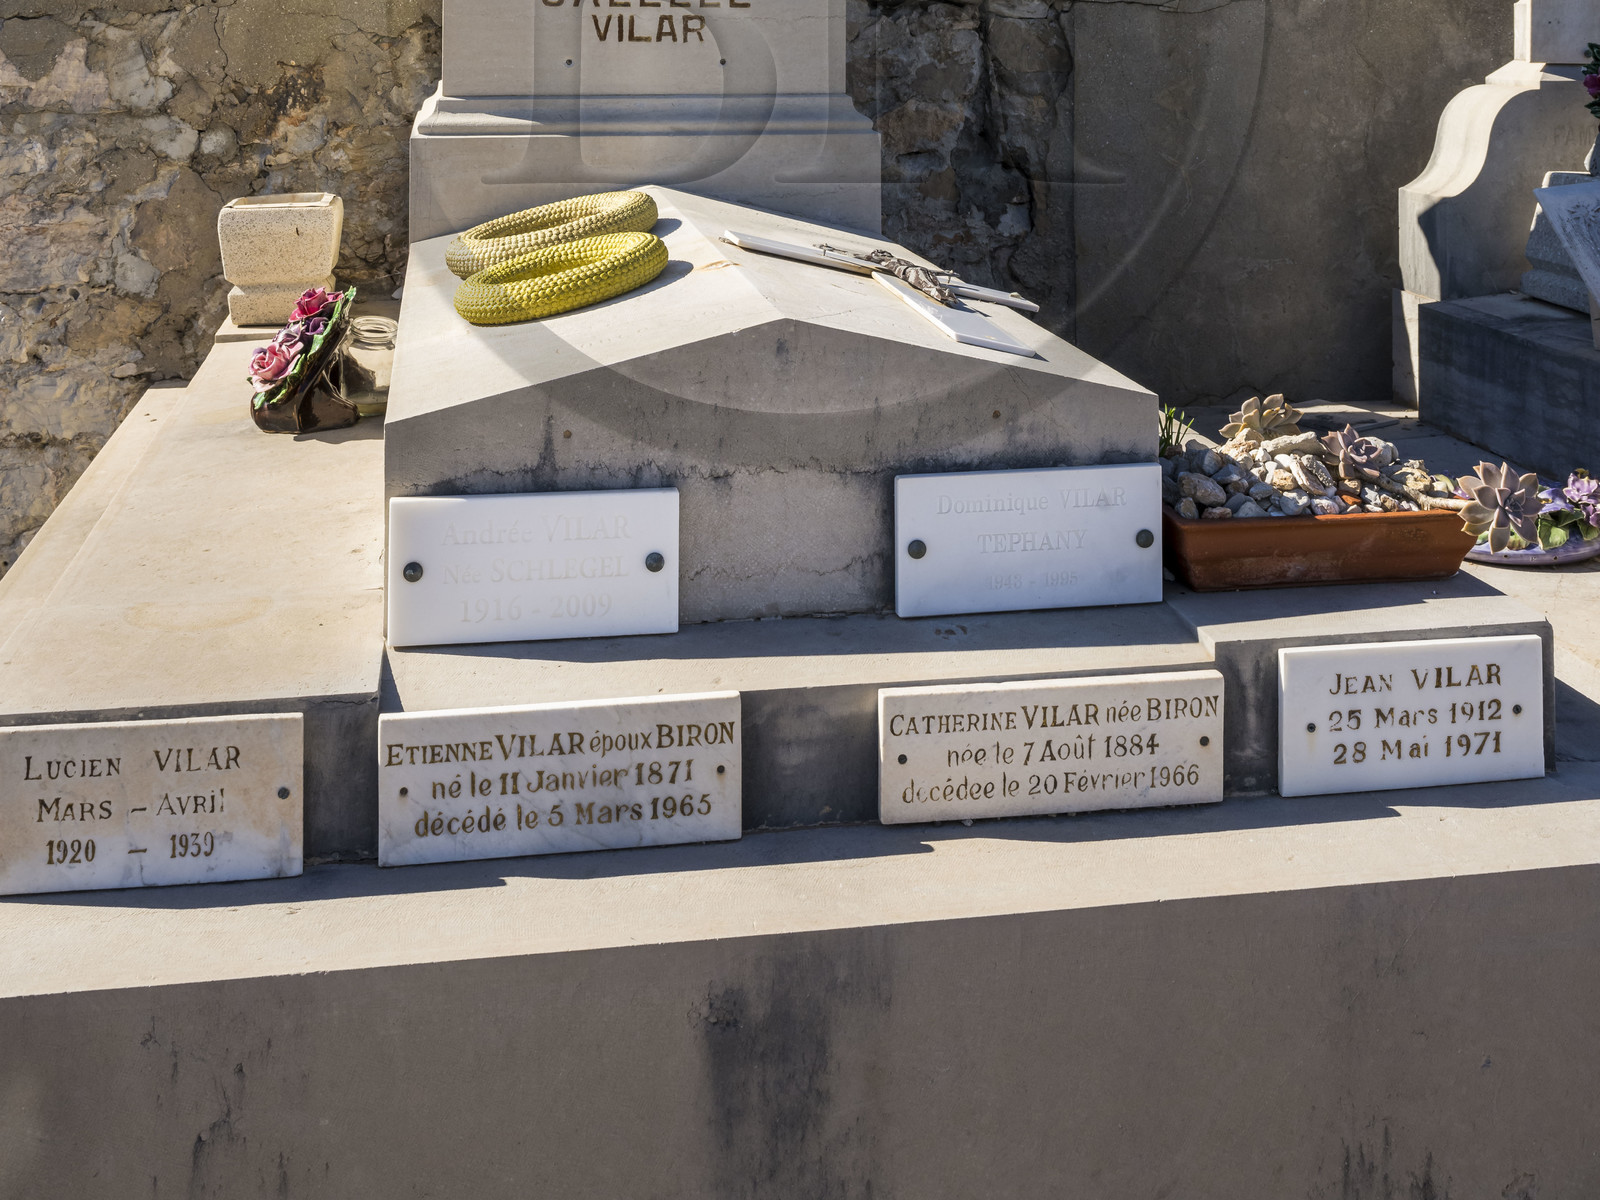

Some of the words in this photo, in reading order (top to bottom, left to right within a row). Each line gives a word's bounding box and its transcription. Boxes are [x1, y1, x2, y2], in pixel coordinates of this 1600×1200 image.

[591, 14, 706, 43] VILAR
[936, 492, 1049, 516] Dominique
[1058, 486, 1127, 509] VILAR
[440, 520, 533, 546] Andrée
[542, 514, 631, 542] VILAR
[976, 529, 1088, 554] TEPHANY
[442, 564, 481, 585] Née
[490, 555, 629, 583] SCHLEGEL
[460, 594, 522, 624] 1916
[549, 592, 613, 618] 2009
[1329, 673, 1393, 696] JEAN
[1410, 663, 1502, 690] VILAR
[889, 711, 1017, 737] CATHERINE
[1020, 703, 1100, 730] VILAR
[1106, 701, 1142, 724] née
[1146, 695, 1219, 721] BIRON
[1329, 709, 1362, 732] 25
[1374, 707, 1438, 729] Mars
[1450, 698, 1502, 724] 1912
[385, 740, 493, 768] ETIENNE
[494, 732, 586, 761] VILAR
[589, 729, 653, 757] époux
[656, 721, 735, 749] BIRON
[947, 744, 987, 767] née
[996, 740, 1014, 765] le
[1023, 742, 1034, 766] 7
[1039, 734, 1096, 763] Août
[1104, 733, 1160, 759] 1884
[1333, 741, 1367, 765] 28
[1380, 734, 1429, 761] Mai
[1445, 730, 1502, 757] 1971
[24, 756, 122, 781] LUCIEN
[153, 746, 241, 772] VILAR
[432, 774, 461, 800] né
[471, 771, 492, 797] le
[499, 772, 520, 795] 11
[527, 764, 629, 793] Janvier
[635, 759, 695, 787] 1871
[1002, 771, 1020, 798] le
[1028, 773, 1058, 796] 20
[1063, 768, 1147, 794] Février
[1149, 763, 1200, 789] 1966
[36, 797, 113, 823] MARS
[414, 807, 507, 838] décédé
[516, 803, 539, 831] le
[547, 805, 565, 827] 5
[575, 801, 643, 826] Mars
[650, 793, 712, 820] 1965
[46, 839, 96, 865] 1920
[169, 831, 215, 859] 1939
